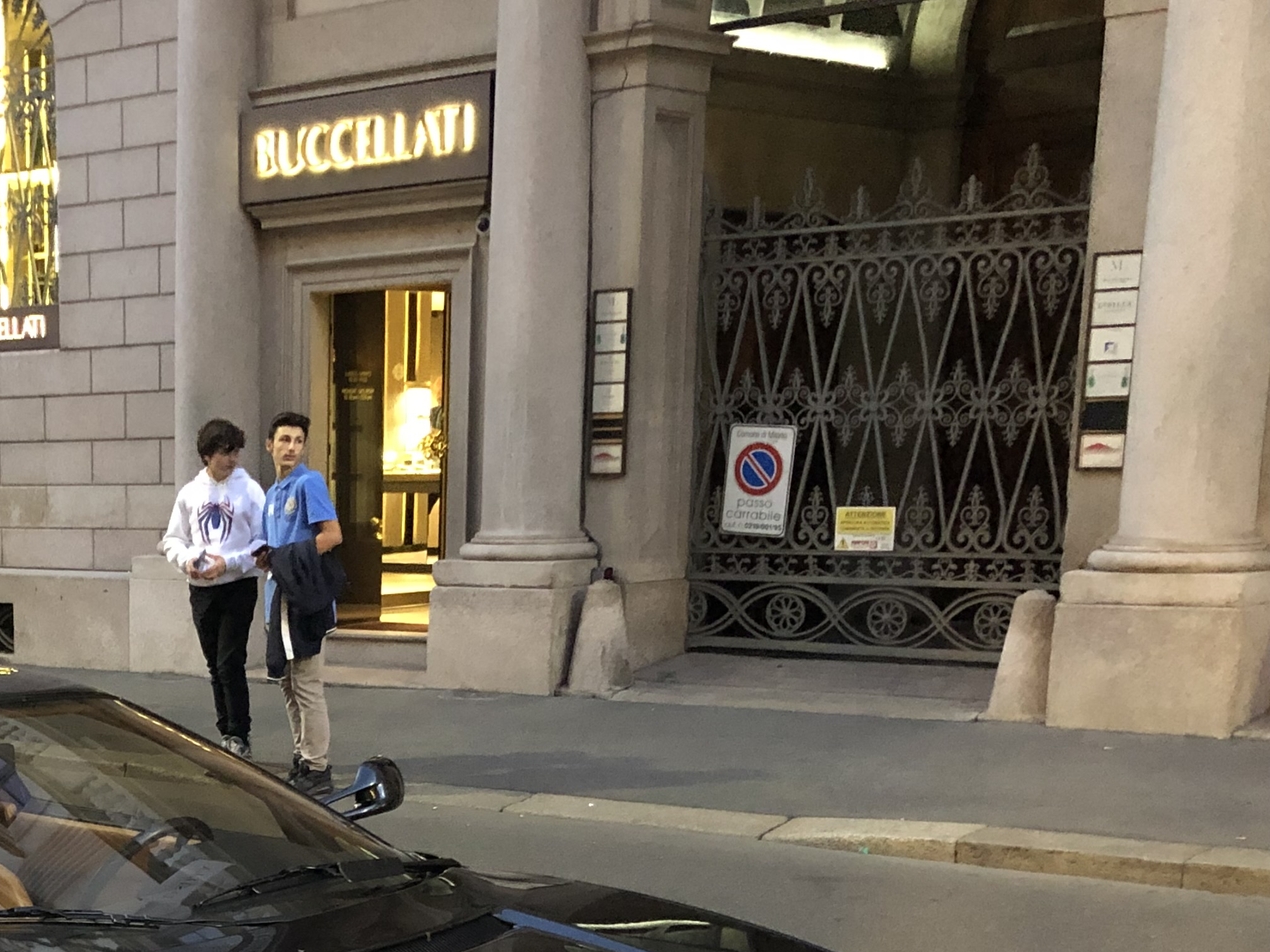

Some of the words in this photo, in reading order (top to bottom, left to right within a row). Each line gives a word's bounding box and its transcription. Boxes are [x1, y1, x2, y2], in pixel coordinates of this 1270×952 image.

[254, 102, 476, 178] BUCCELLATI
[736, 498, 773, 509] passo
[725, 509, 782, 521] carrabile
